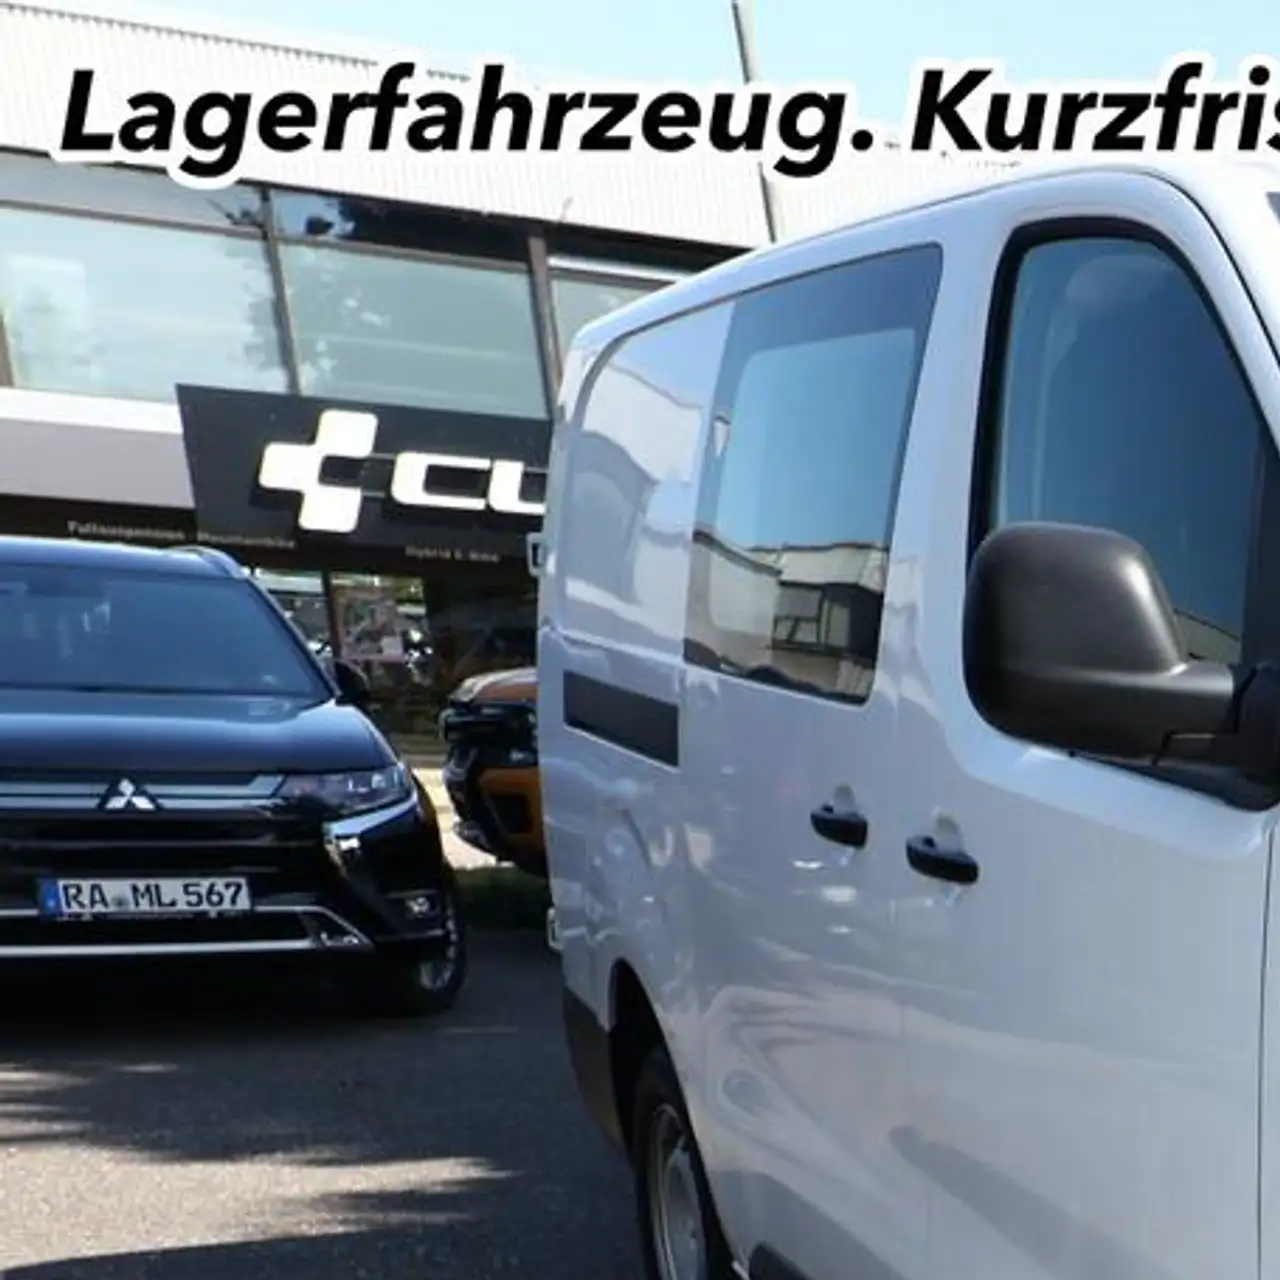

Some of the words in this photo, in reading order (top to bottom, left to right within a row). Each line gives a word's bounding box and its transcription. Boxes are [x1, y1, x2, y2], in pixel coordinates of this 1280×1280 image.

[62, 883, 109, 909] RA
[131, 883, 177, 908] ML
[182, 882, 243, 908] 567
